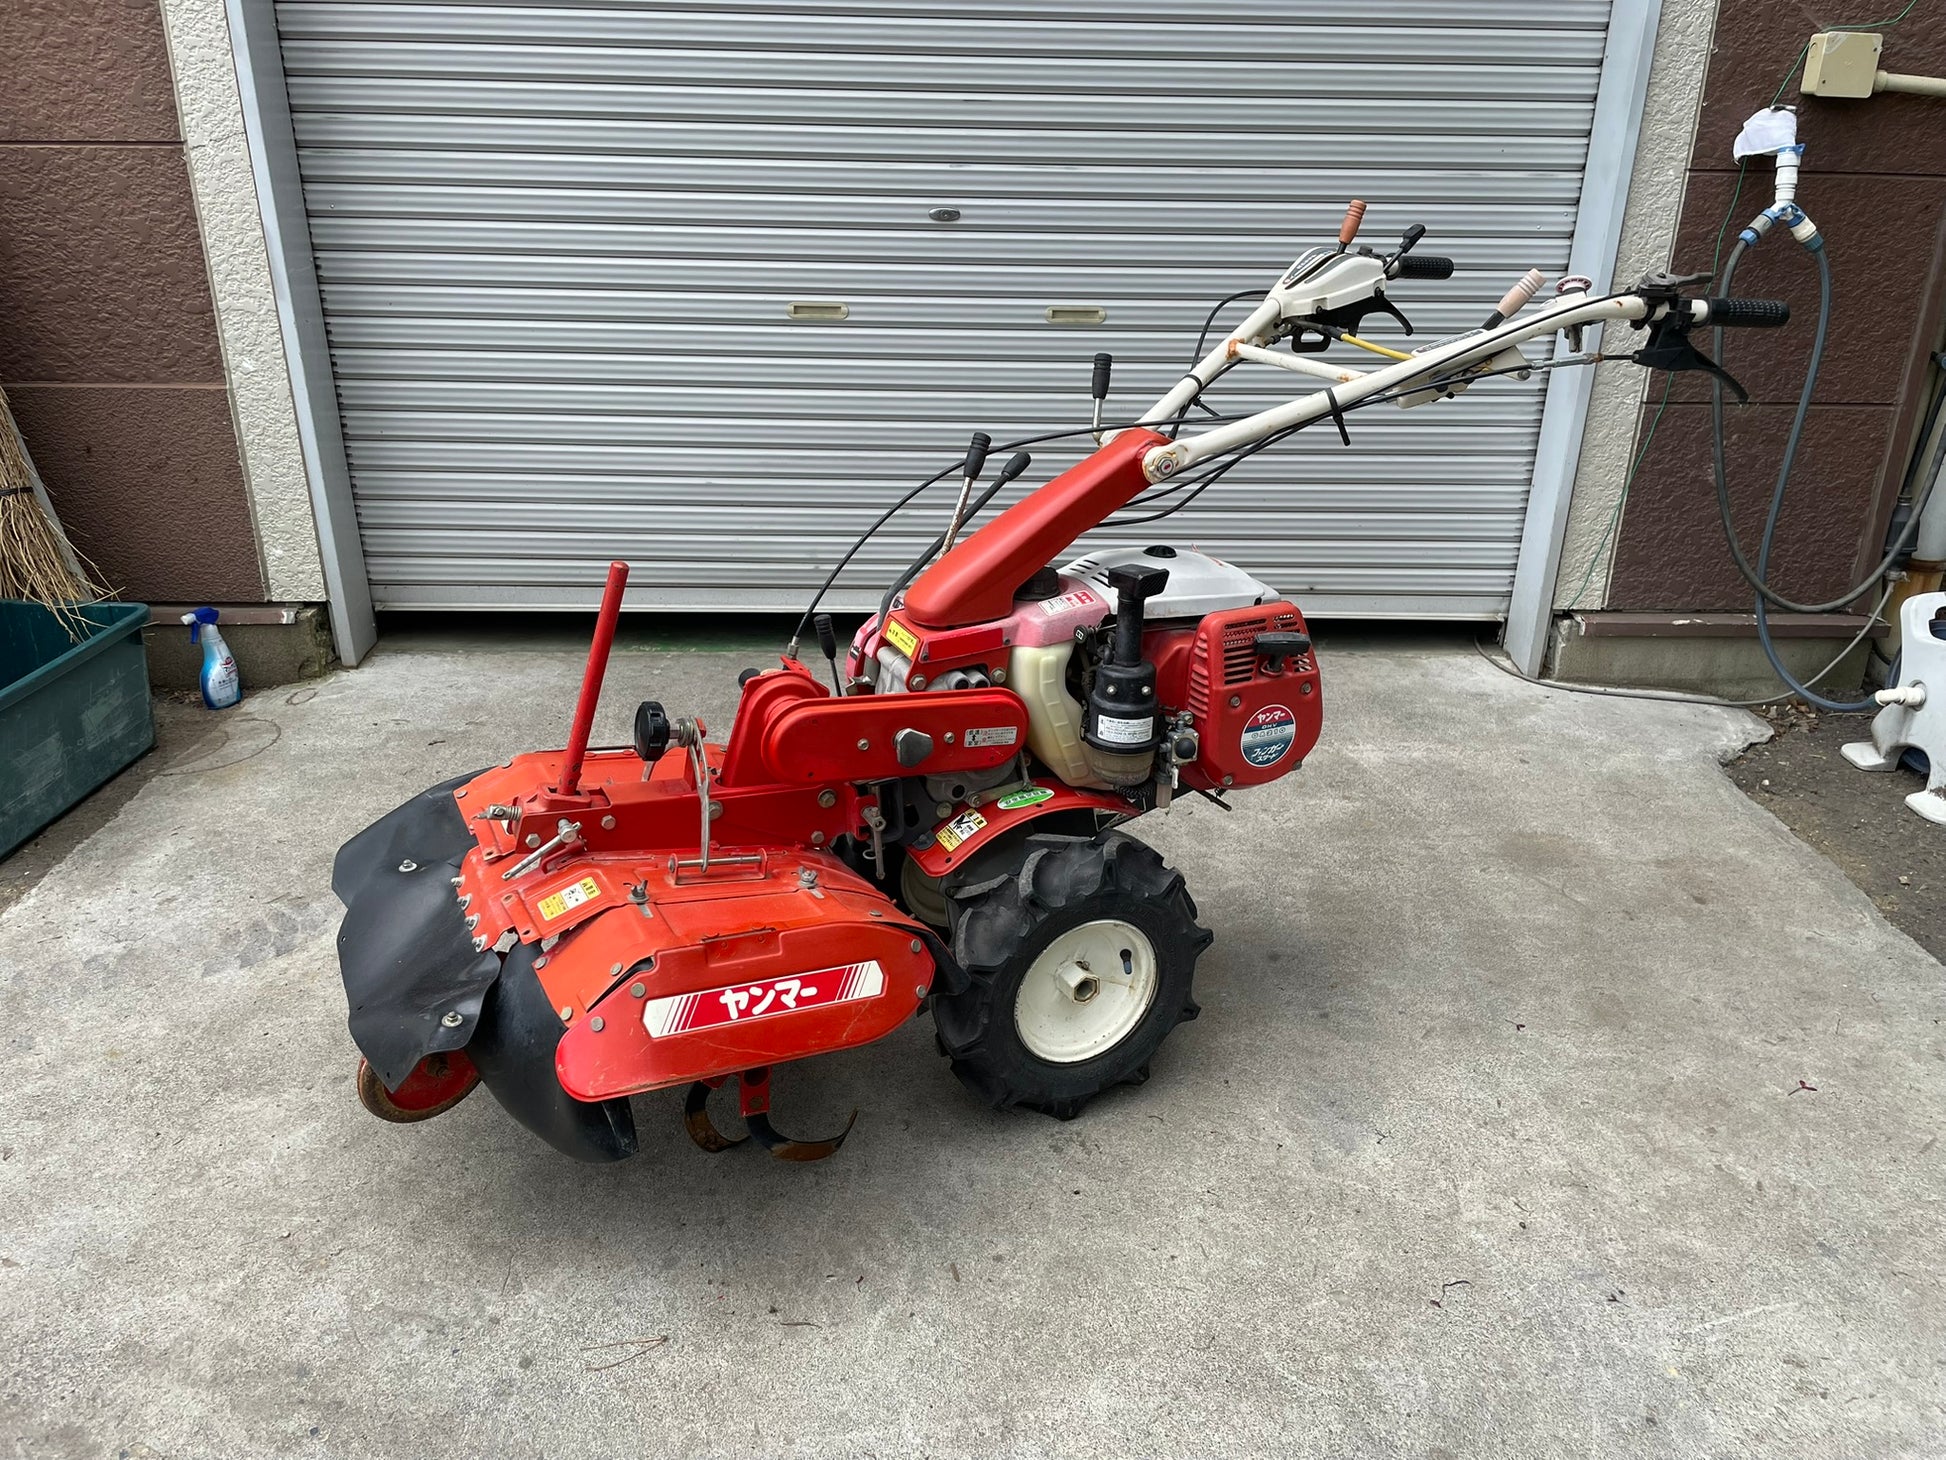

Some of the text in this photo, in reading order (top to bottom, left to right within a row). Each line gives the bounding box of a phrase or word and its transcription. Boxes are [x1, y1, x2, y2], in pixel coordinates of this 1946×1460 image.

[1257, 710, 1286, 723] ヤンマー
[719, 979, 818, 1020] ヤンマー
